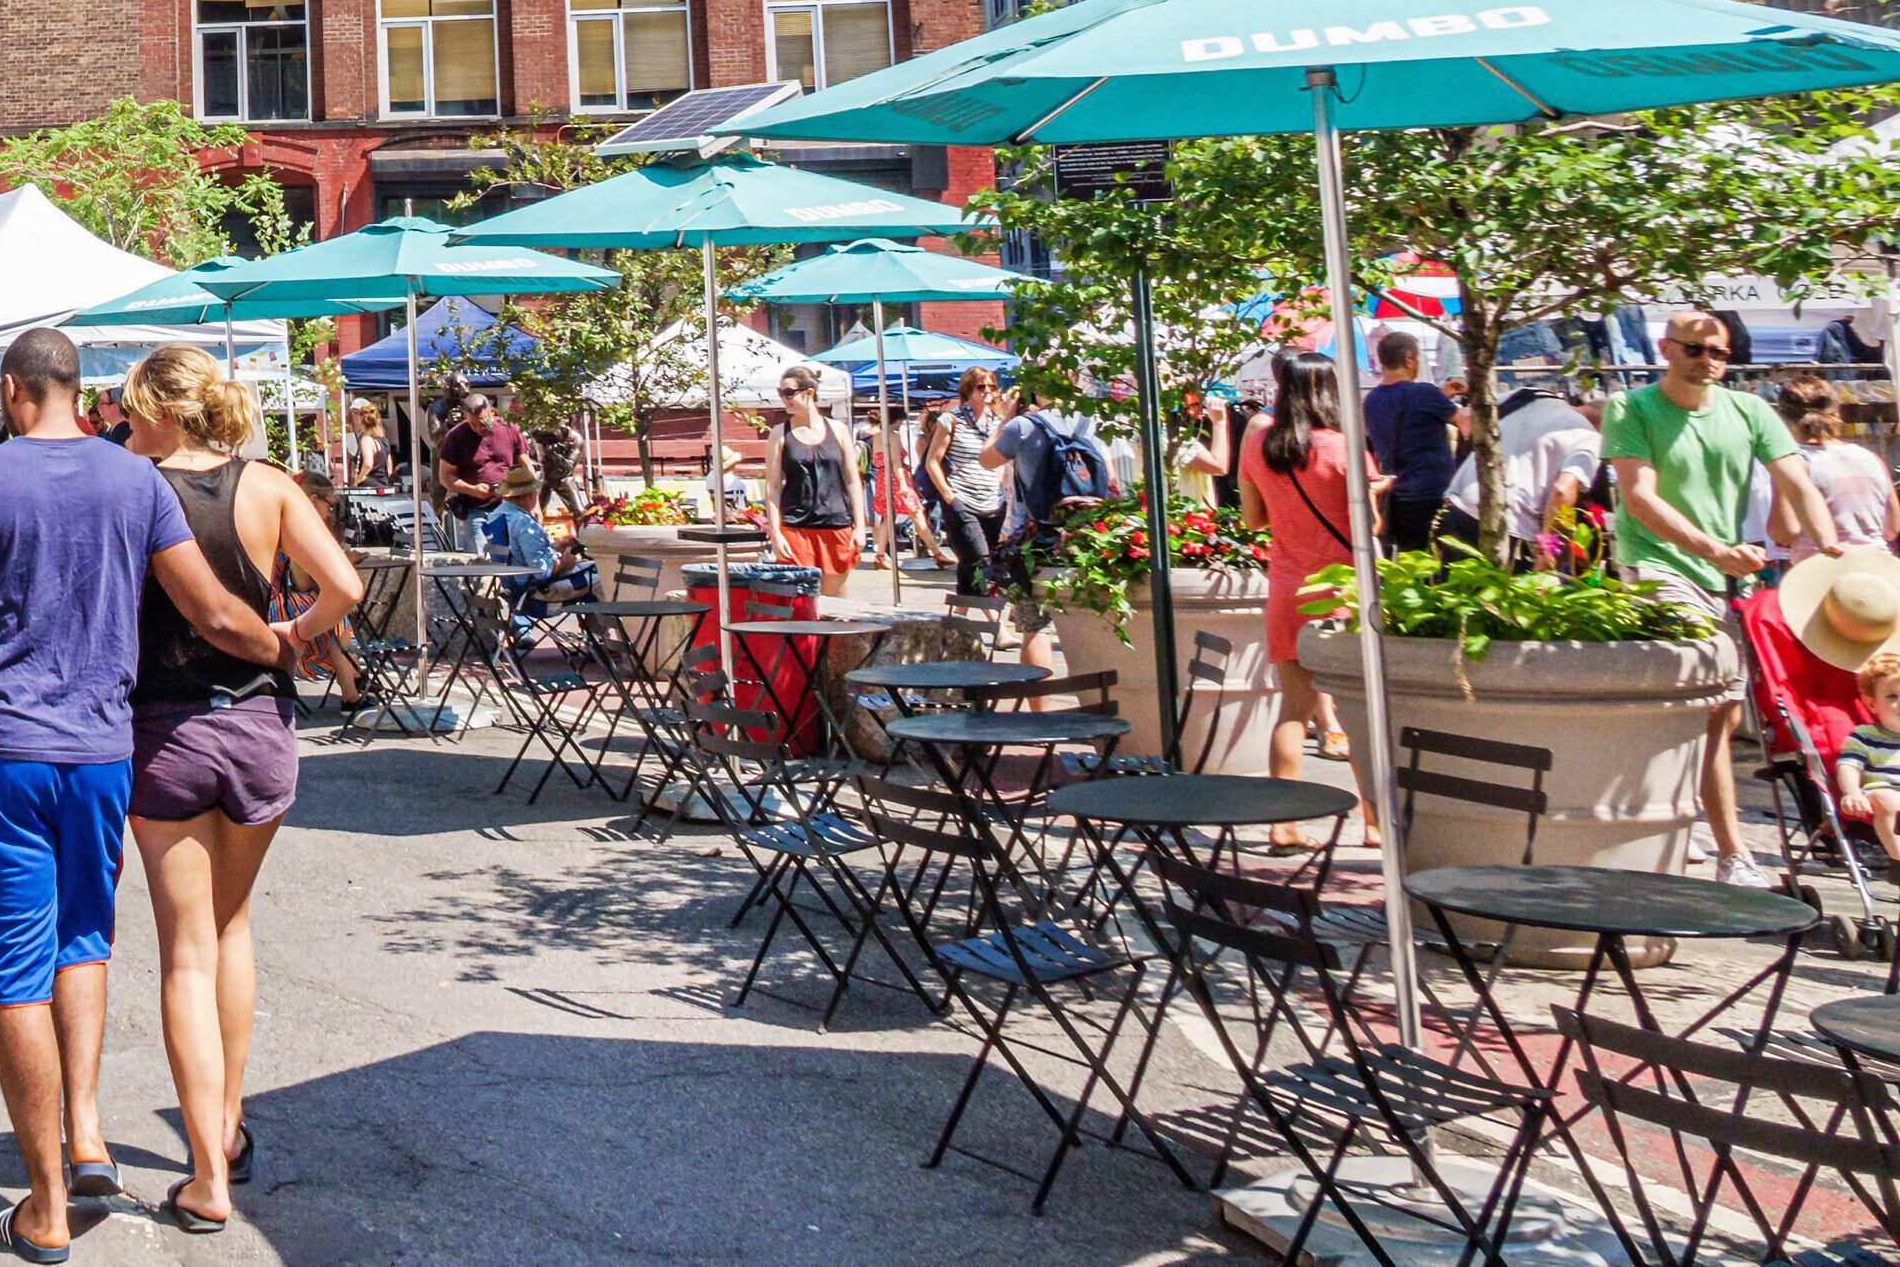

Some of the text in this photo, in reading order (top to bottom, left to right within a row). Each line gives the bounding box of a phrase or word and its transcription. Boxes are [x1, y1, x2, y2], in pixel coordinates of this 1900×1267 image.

[1180, 5, 1552, 63] DUMBO
[782, 199, 906, 222] DUMBO
[434, 258, 539, 273] DUMBO
